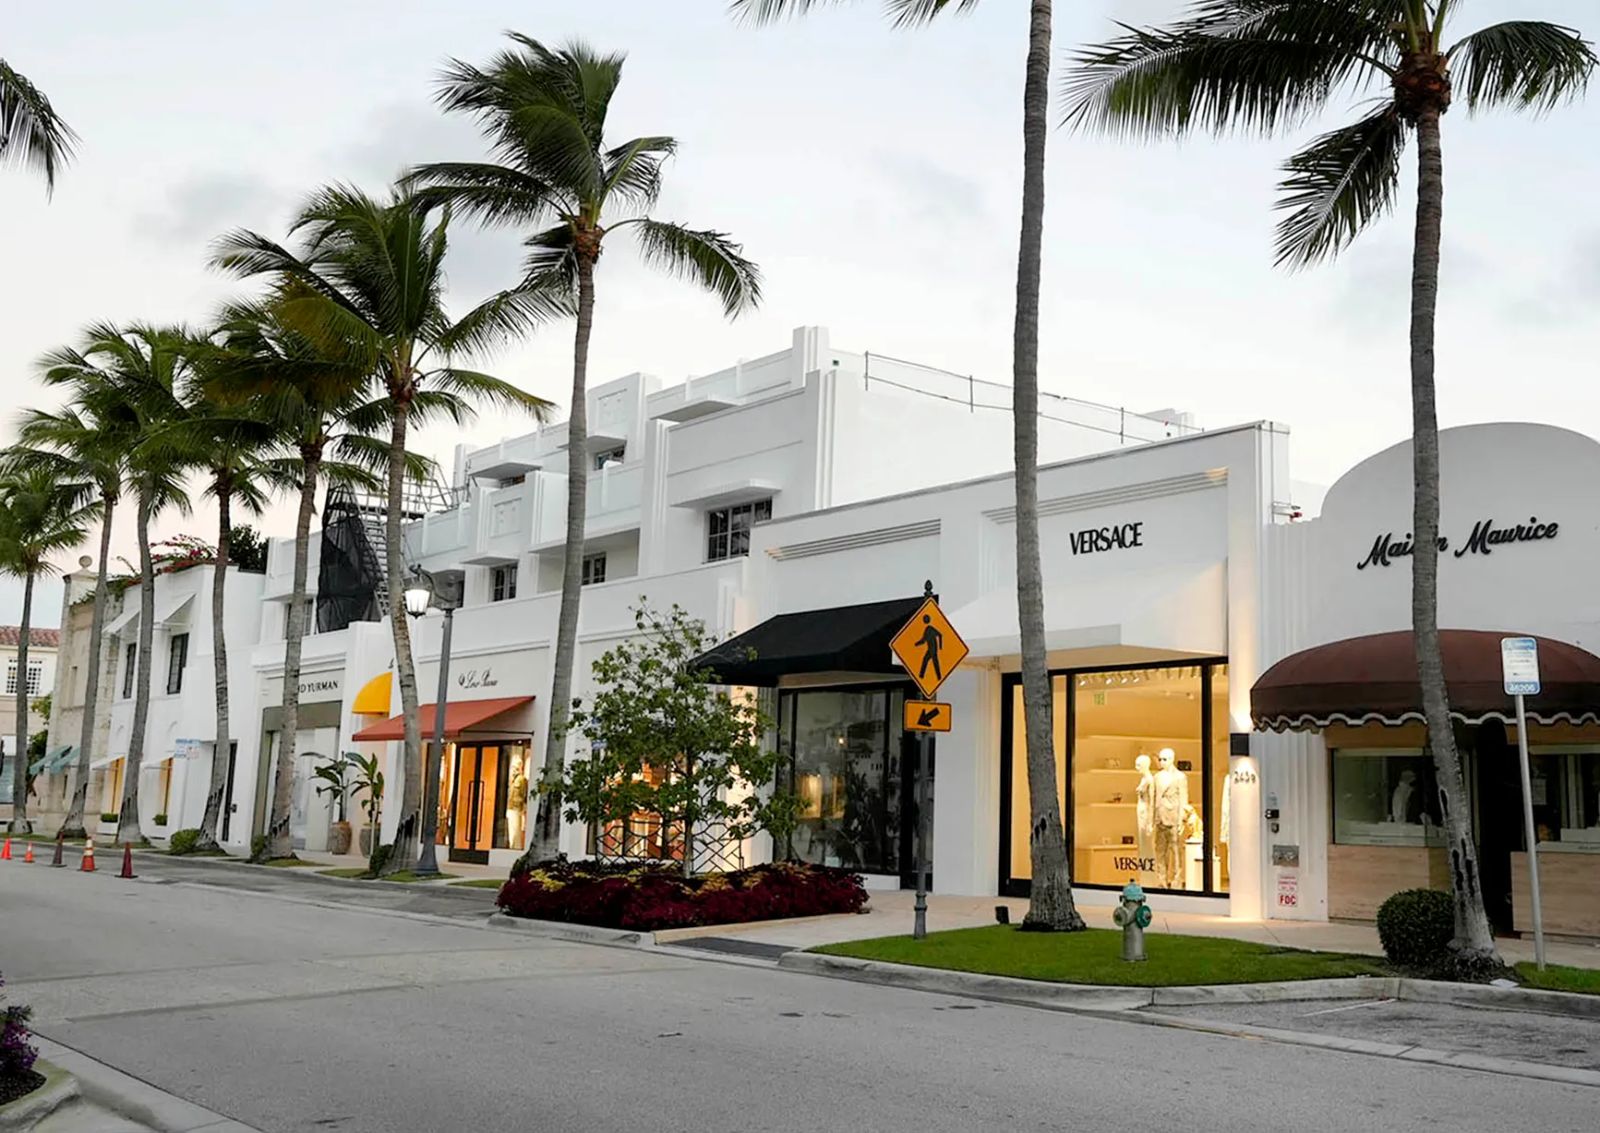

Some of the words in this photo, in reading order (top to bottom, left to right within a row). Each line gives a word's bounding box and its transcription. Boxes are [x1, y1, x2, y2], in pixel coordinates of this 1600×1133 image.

[1069, 521, 1144, 556] VERSACE
[1357, 532, 1449, 570] Main
[1454, 515, 1560, 558] Maurice
[1113, 856, 1156, 872] VERSACE
